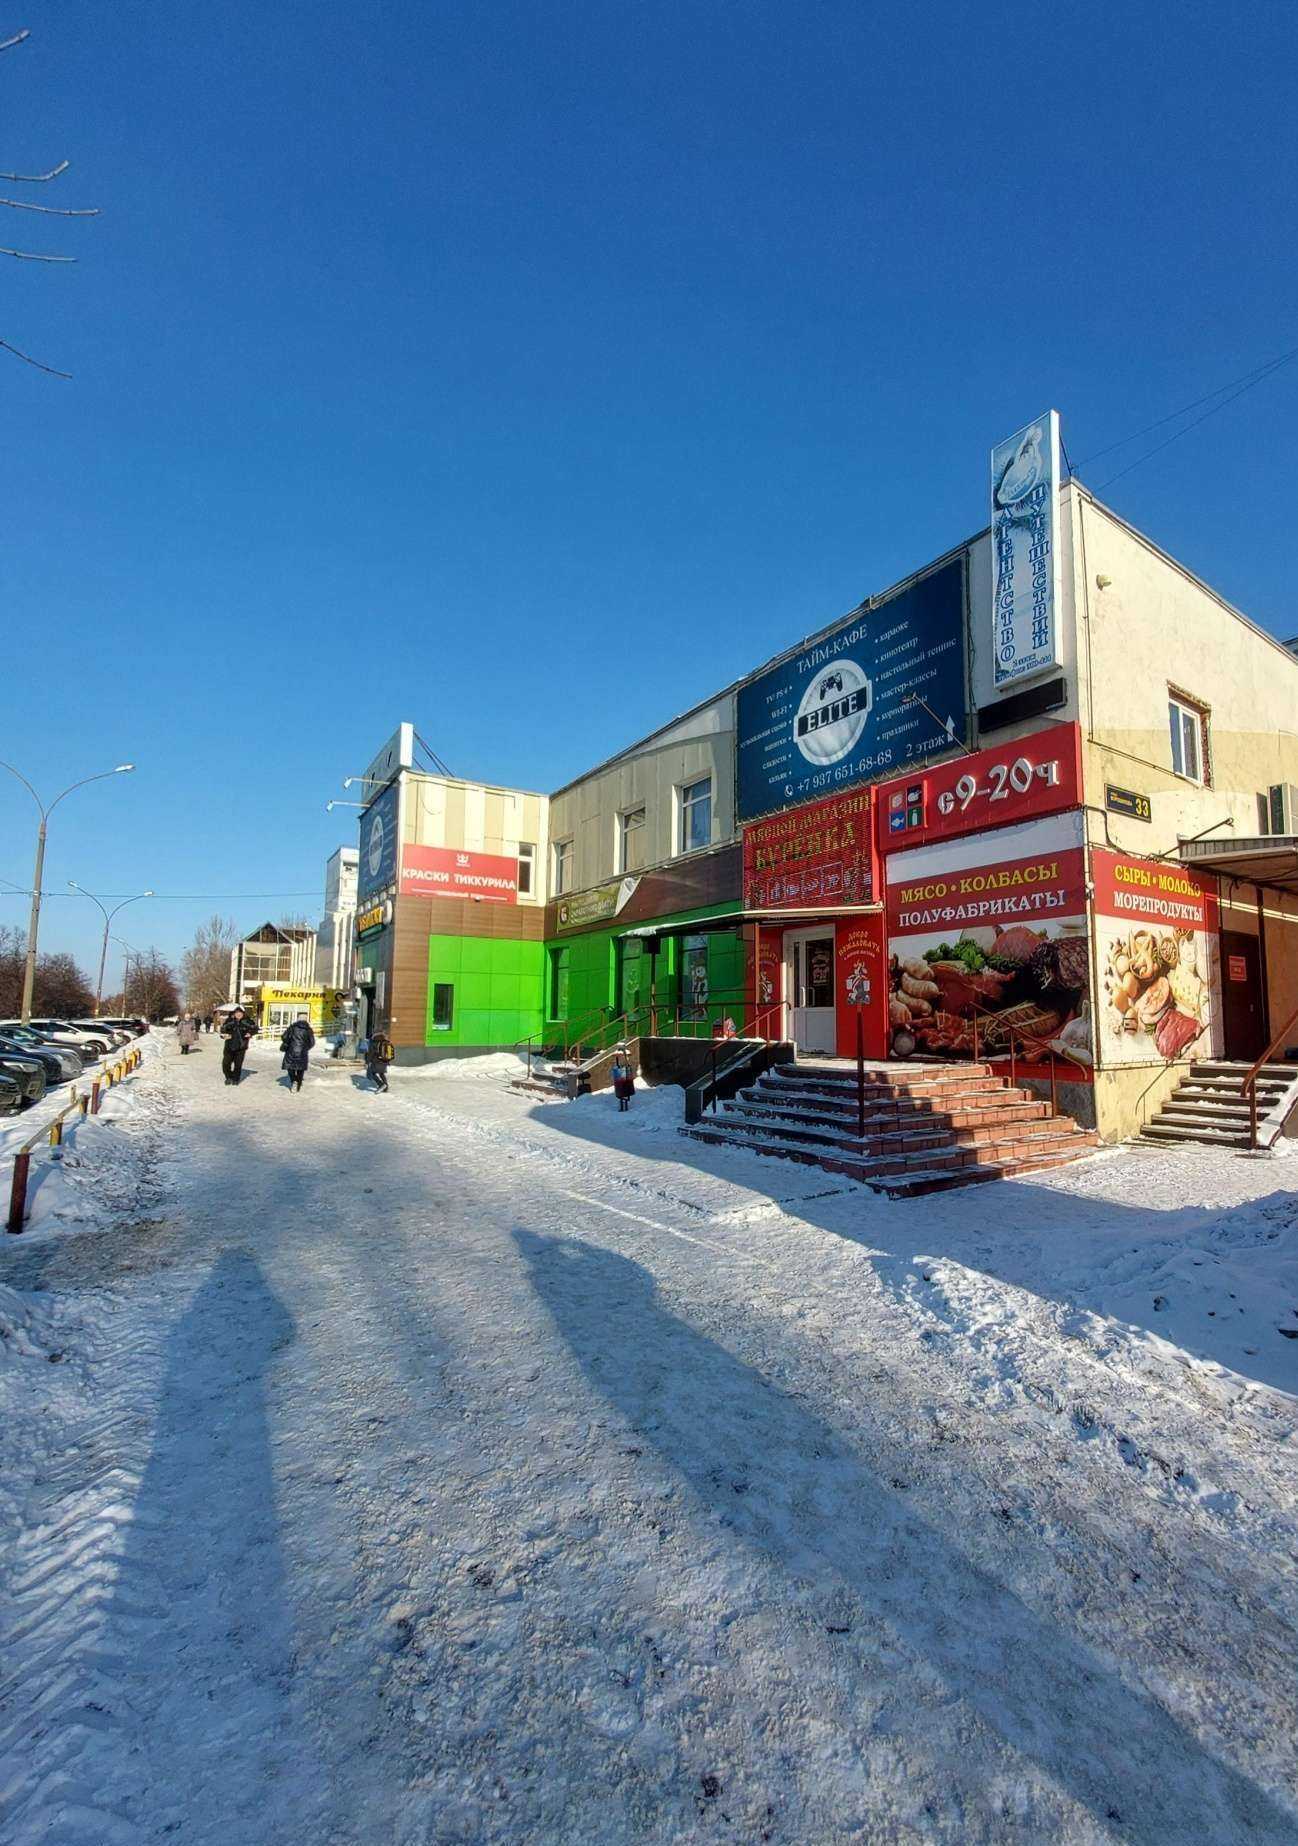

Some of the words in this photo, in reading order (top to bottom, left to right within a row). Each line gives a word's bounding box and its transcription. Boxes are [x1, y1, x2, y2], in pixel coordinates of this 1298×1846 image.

[999, 503, 1016, 662] АГЕНТСТВО
[796, 623, 869, 674] ТАЙМ-КАФЕ
[806, 693, 859, 731] ELITE
[880, 694, 929, 721] корпоратиы
[905, 743, 914, 757] 2
[915, 733, 945, 754] этаж
[812, 771, 832, 788] 937
[834, 748, 893, 781] 651-68-68
[1135, 797, 1149, 817] 33
[402, 868, 449, 882] КРАСКИ
[454, 874, 517, 890] ТИККУРИЛА
[901, 884, 947, 903] МЯСО
[960, 863, 1058, 894] КОЛБАСЫ
[1114, 864, 1151, 887] СЫРЫ
[1158, 876, 1201, 897] МОЛОКО
[899, 890, 1065, 927] ПОЛУФАБРИКАТЫ
[1113, 891, 1203, 922] МОРЕПРОДУКТЫ
